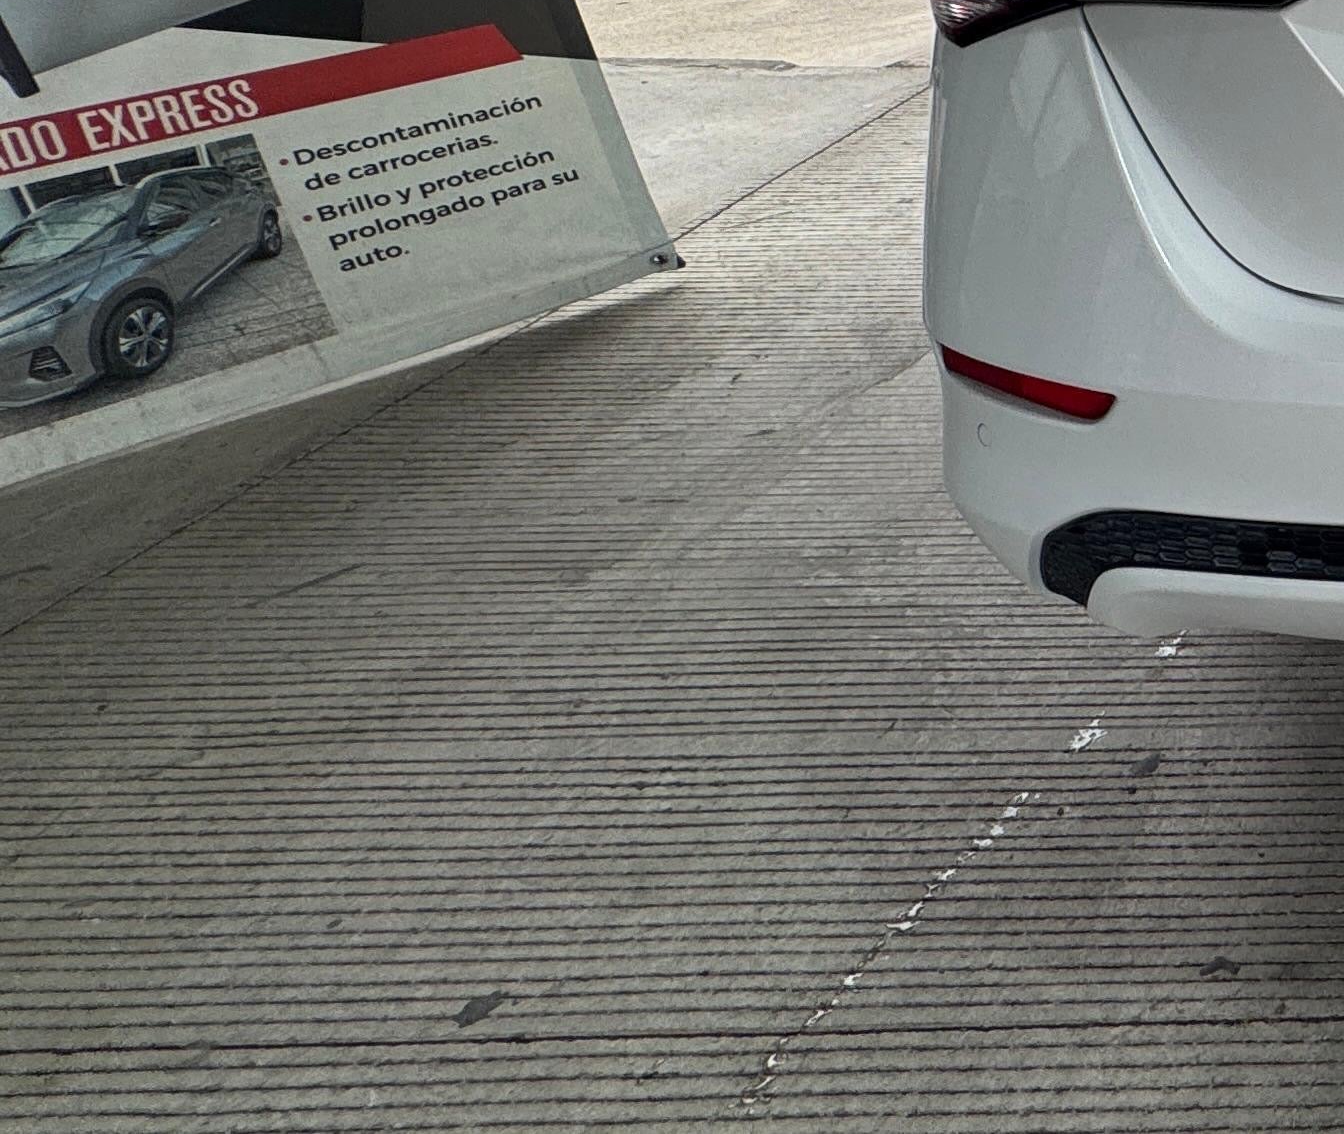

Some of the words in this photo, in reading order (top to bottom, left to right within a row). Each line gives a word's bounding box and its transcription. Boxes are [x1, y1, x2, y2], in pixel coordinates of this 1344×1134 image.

[0, 120, 67, 170] DO
[77, 79, 259, 151] EXPRESS
[293, 95, 543, 167] Descontaminación
[304, 171, 341, 191] de
[348, 132, 499, 179] carrocerias.
[316, 189, 391, 222] Brillo
[395, 186, 412, 205] y
[418, 148, 555, 198] protección
[328, 193, 485, 251] prolongado
[490, 178, 547, 206] para
[551, 168, 579, 186] su
[339, 242, 411, 273] auto.
